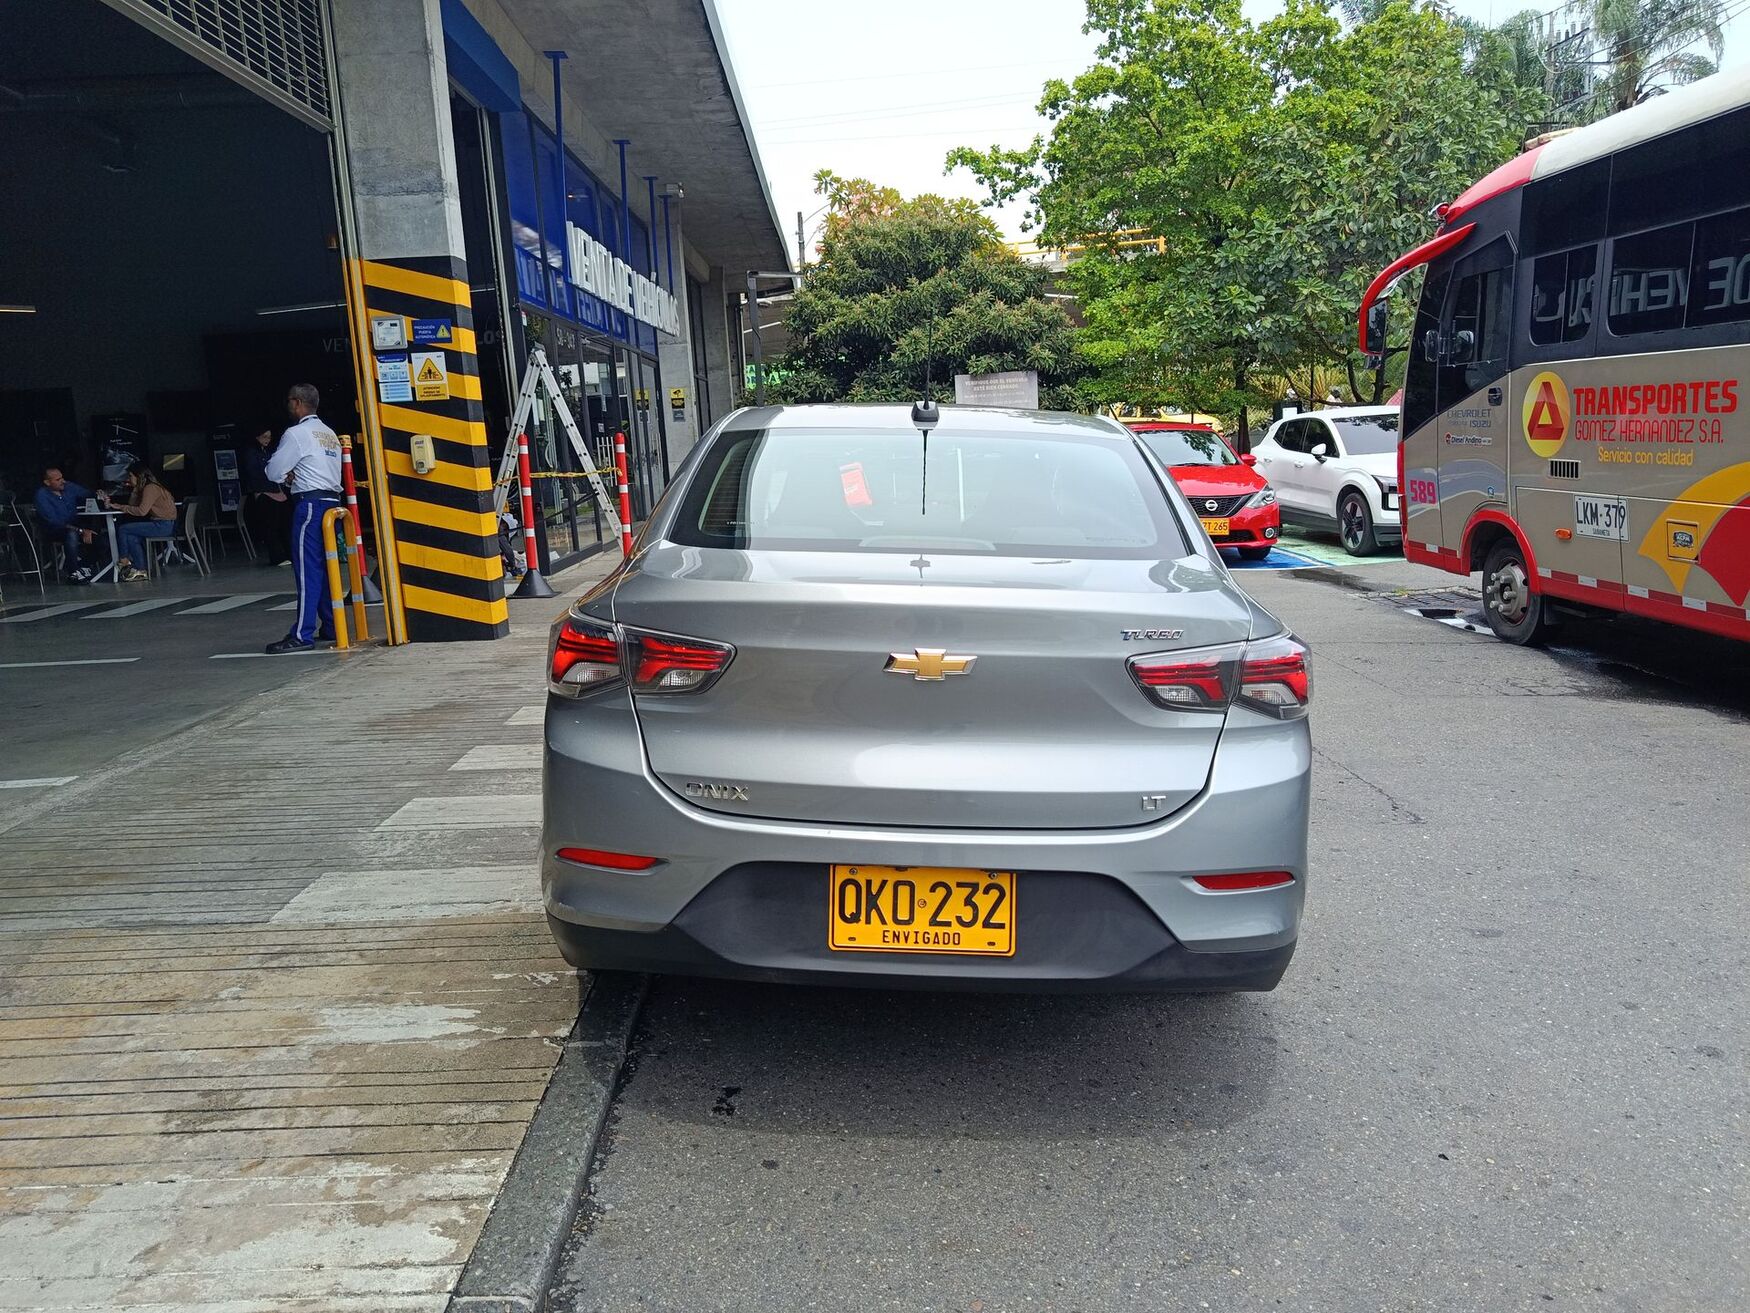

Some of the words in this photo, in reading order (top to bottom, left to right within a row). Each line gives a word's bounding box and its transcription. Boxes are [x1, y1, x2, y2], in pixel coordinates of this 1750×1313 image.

[566, 221, 617, 306] VENTA
[613, 257, 634, 315] DE
[1573, 380, 1738, 416] TRANSPORTES
[1447, 408, 1491, 418] CHEVROLET
[1470, 420, 1491, 428] ISUZU
[1575, 420, 1616, 441] GOMEZ
[1619, 419, 1695, 443] HERNANDEZ
[1699, 418, 1723, 443] S.A.
[1451, 436, 1464, 444] Diesel
[1465, 436, 1482, 444] Andino
[1598, 446, 1632, 464] Servicio
[1635, 451, 1651, 465] con
[1656, 449, 1694, 466] calidad
[1410, 480, 1437, 504] 589
[1214, 522, 1228, 531] 265
[1120, 629, 1184, 640] TURBO
[686, 782, 749, 800] ONIX
[1141, 795, 1166, 810] LT
[929, 881, 1007, 930] 232
[883, 930, 961, 946] ENVIGADO
